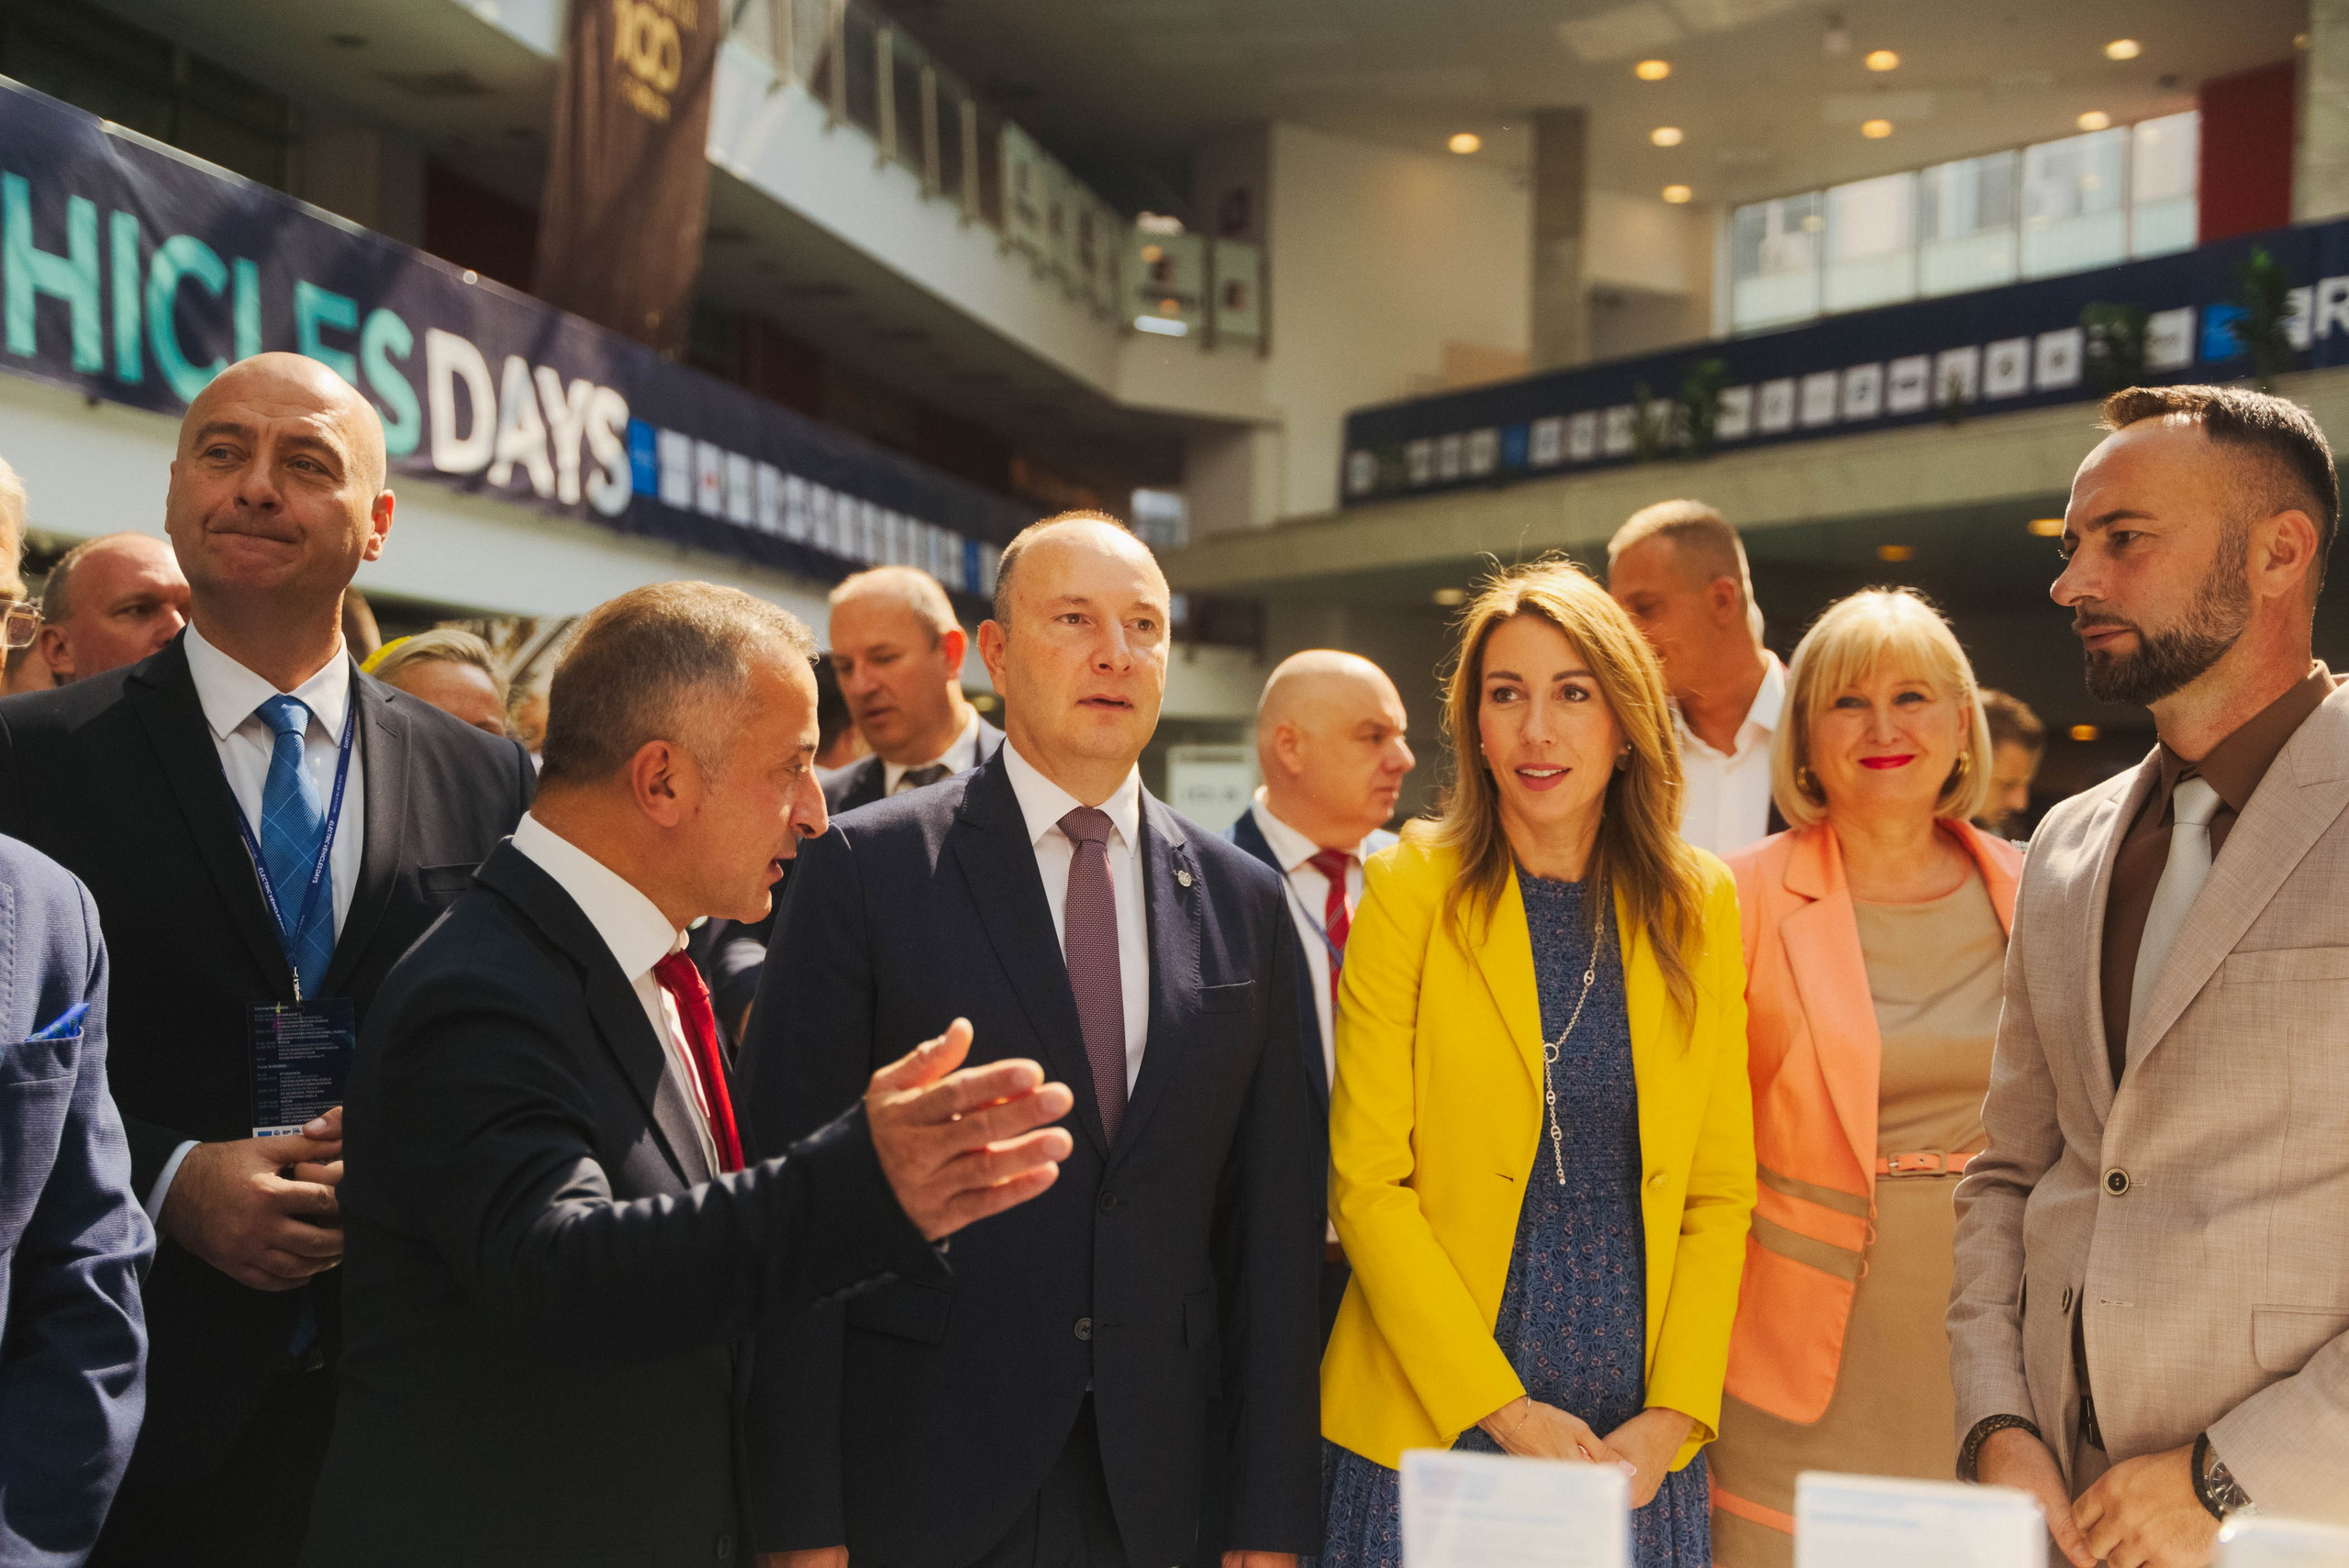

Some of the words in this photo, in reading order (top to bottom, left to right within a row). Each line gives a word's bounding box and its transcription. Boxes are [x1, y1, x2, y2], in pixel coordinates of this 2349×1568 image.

[425, 327, 633, 517] DAYS
[325, 820, 335, 844] ELECTRIC
[317, 844, 328, 869] VEHICLES
[258, 867, 273, 894] ELECTRIC
[312, 869, 322, 884] DAYS
